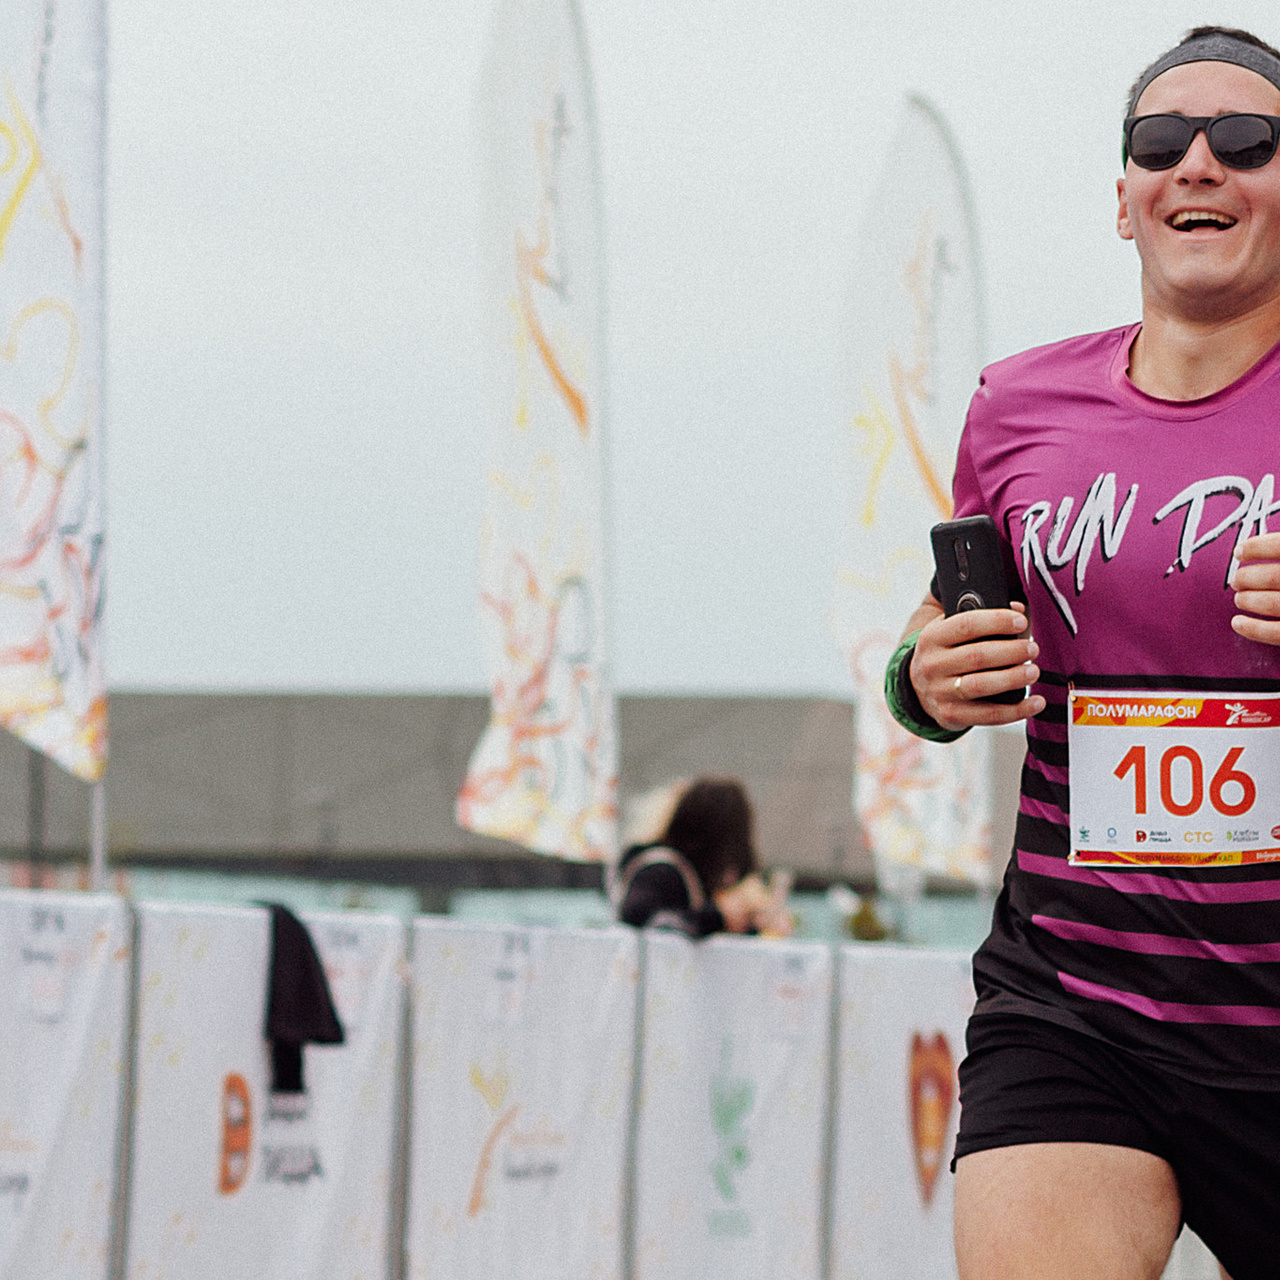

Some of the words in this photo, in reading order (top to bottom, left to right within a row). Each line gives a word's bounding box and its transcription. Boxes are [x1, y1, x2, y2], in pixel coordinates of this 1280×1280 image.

[1021, 472, 1140, 638] RUN
[1087, 704, 1197, 719] ПОЛУМАРАФОН
[1113, 745, 1256, 816] 106
[1184, 831, 1213, 842] СТС
